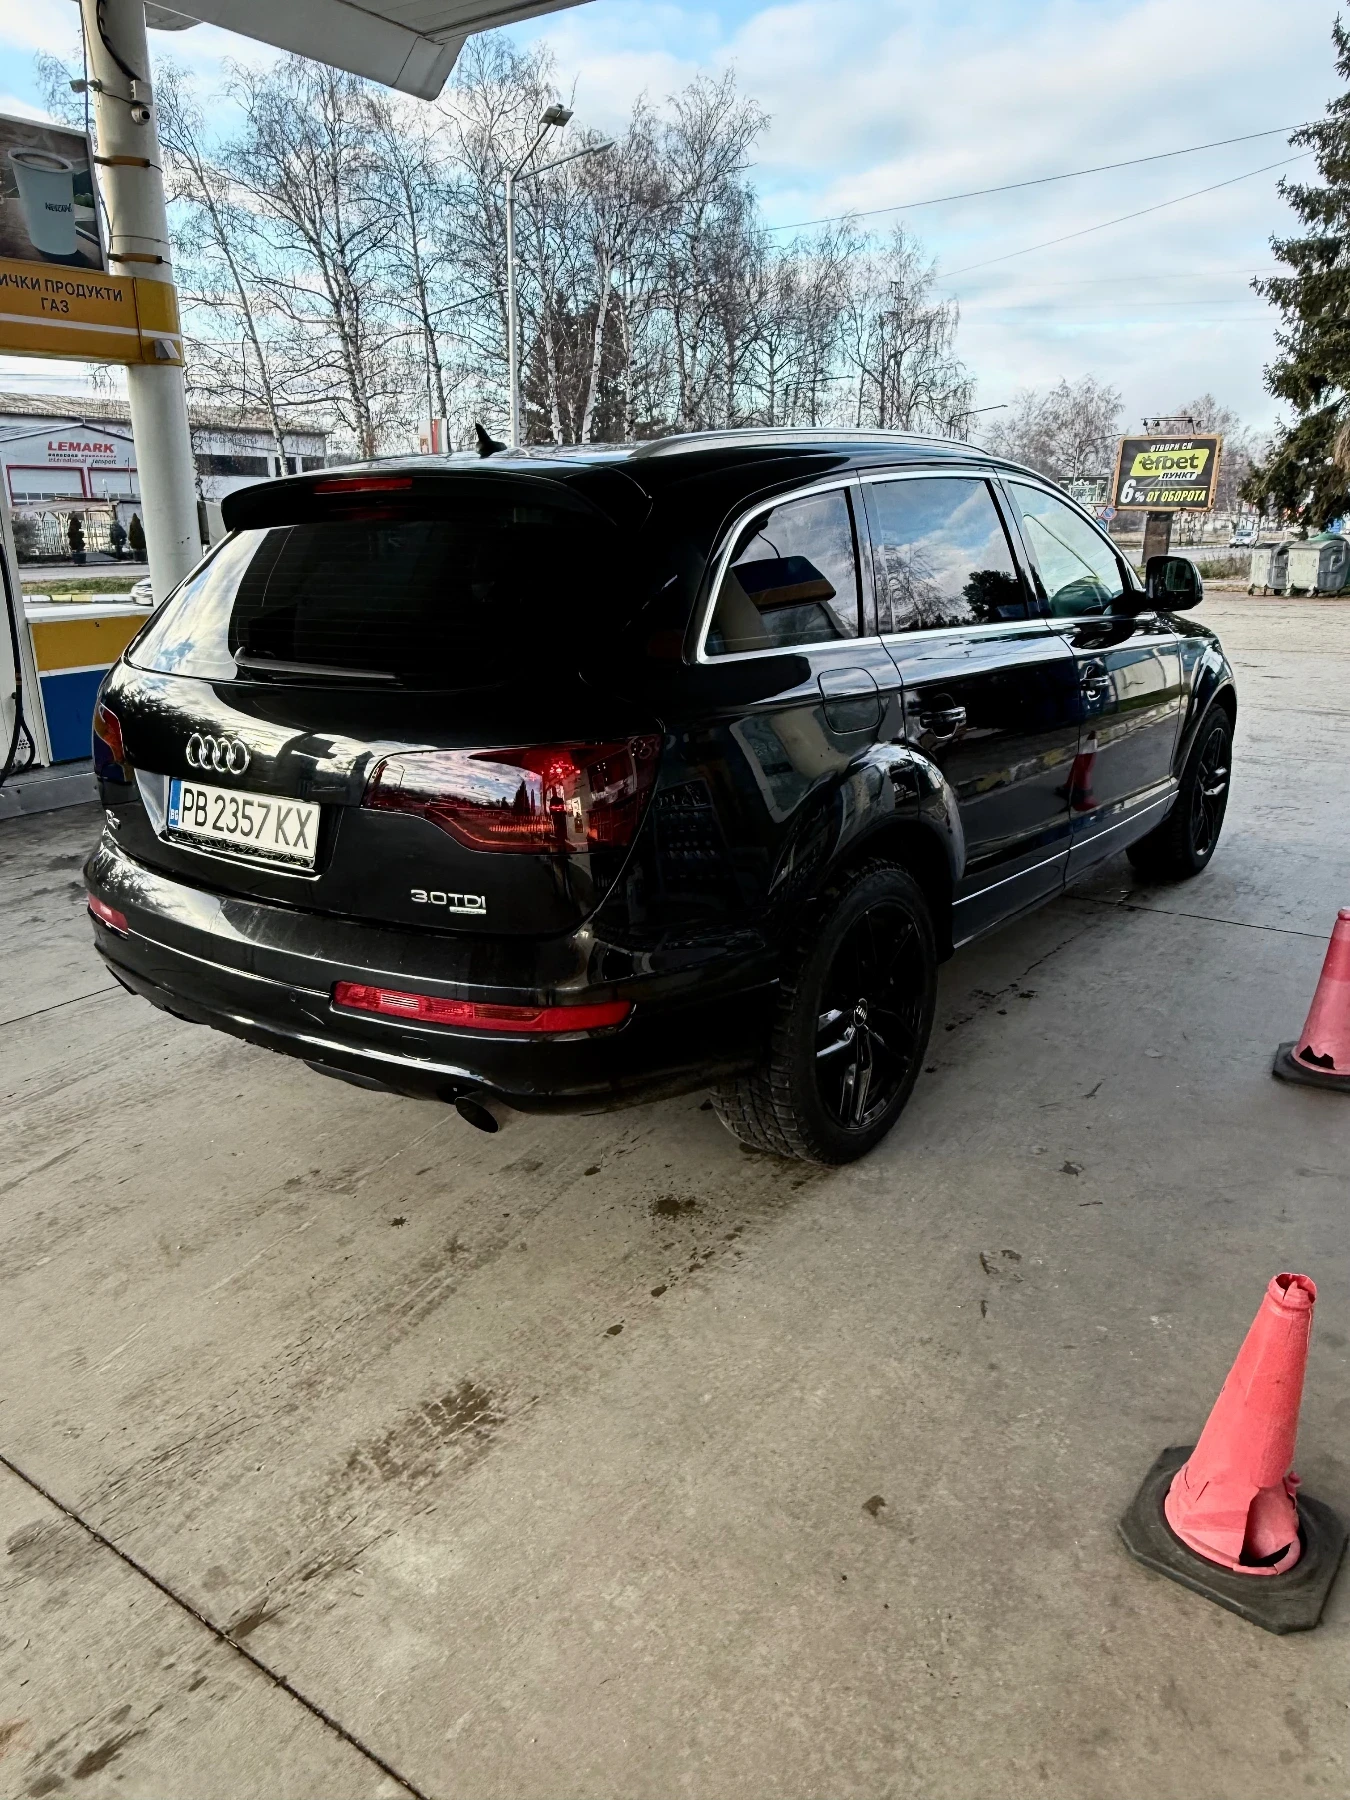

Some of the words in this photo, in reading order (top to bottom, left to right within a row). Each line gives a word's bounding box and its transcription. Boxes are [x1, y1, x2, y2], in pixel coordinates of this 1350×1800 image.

[44, 279, 123, 302] ПРОДУКТИ
[41, 297, 70, 313] ГАЗ
[47, 441, 116, 453] LEMARK
[1150, 443, 1180, 452] ОТВОРИ
[1139, 453, 1199, 470] efbet
[1162, 471, 1195, 479] ПУНКТ
[1146, 491, 1160, 502] ОТ
[1161, 490, 1207, 502] ОБОРОТА
[182, 787, 207, 827] PB
[212, 794, 271, 839] 2357
[274, 804, 312, 849] KX
